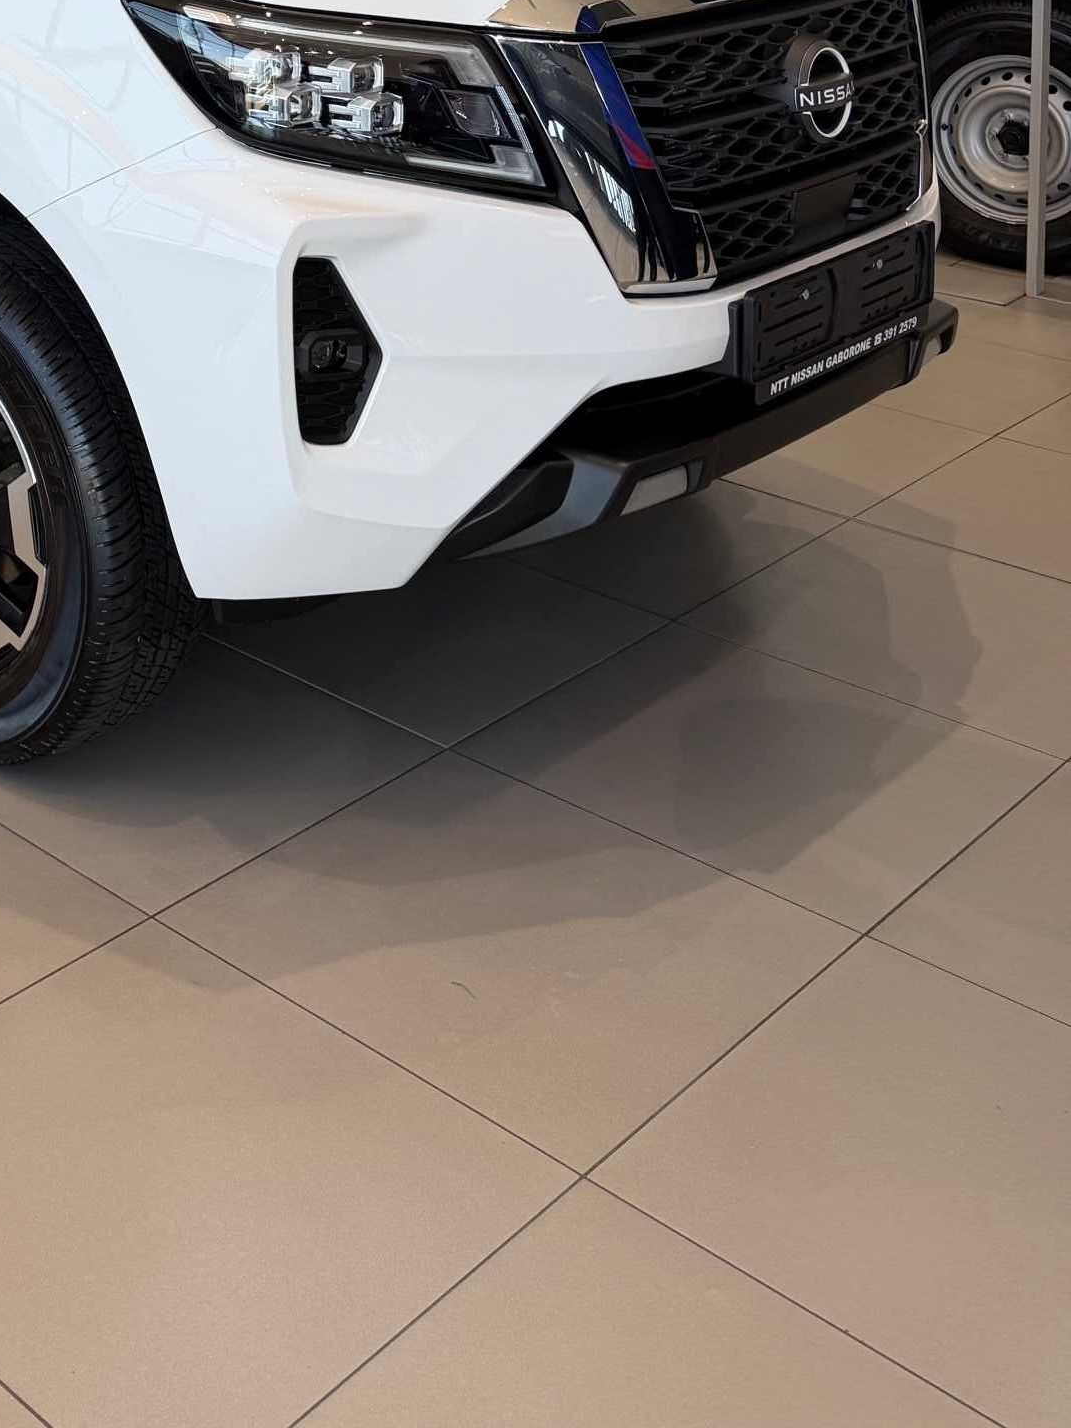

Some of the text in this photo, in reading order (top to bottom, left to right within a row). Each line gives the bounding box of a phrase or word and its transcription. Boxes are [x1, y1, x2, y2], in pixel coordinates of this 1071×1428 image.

[770, 376, 790, 396] NTT
[790, 360, 824, 387] NISSAN
[825, 338, 872, 370] GABORONE
